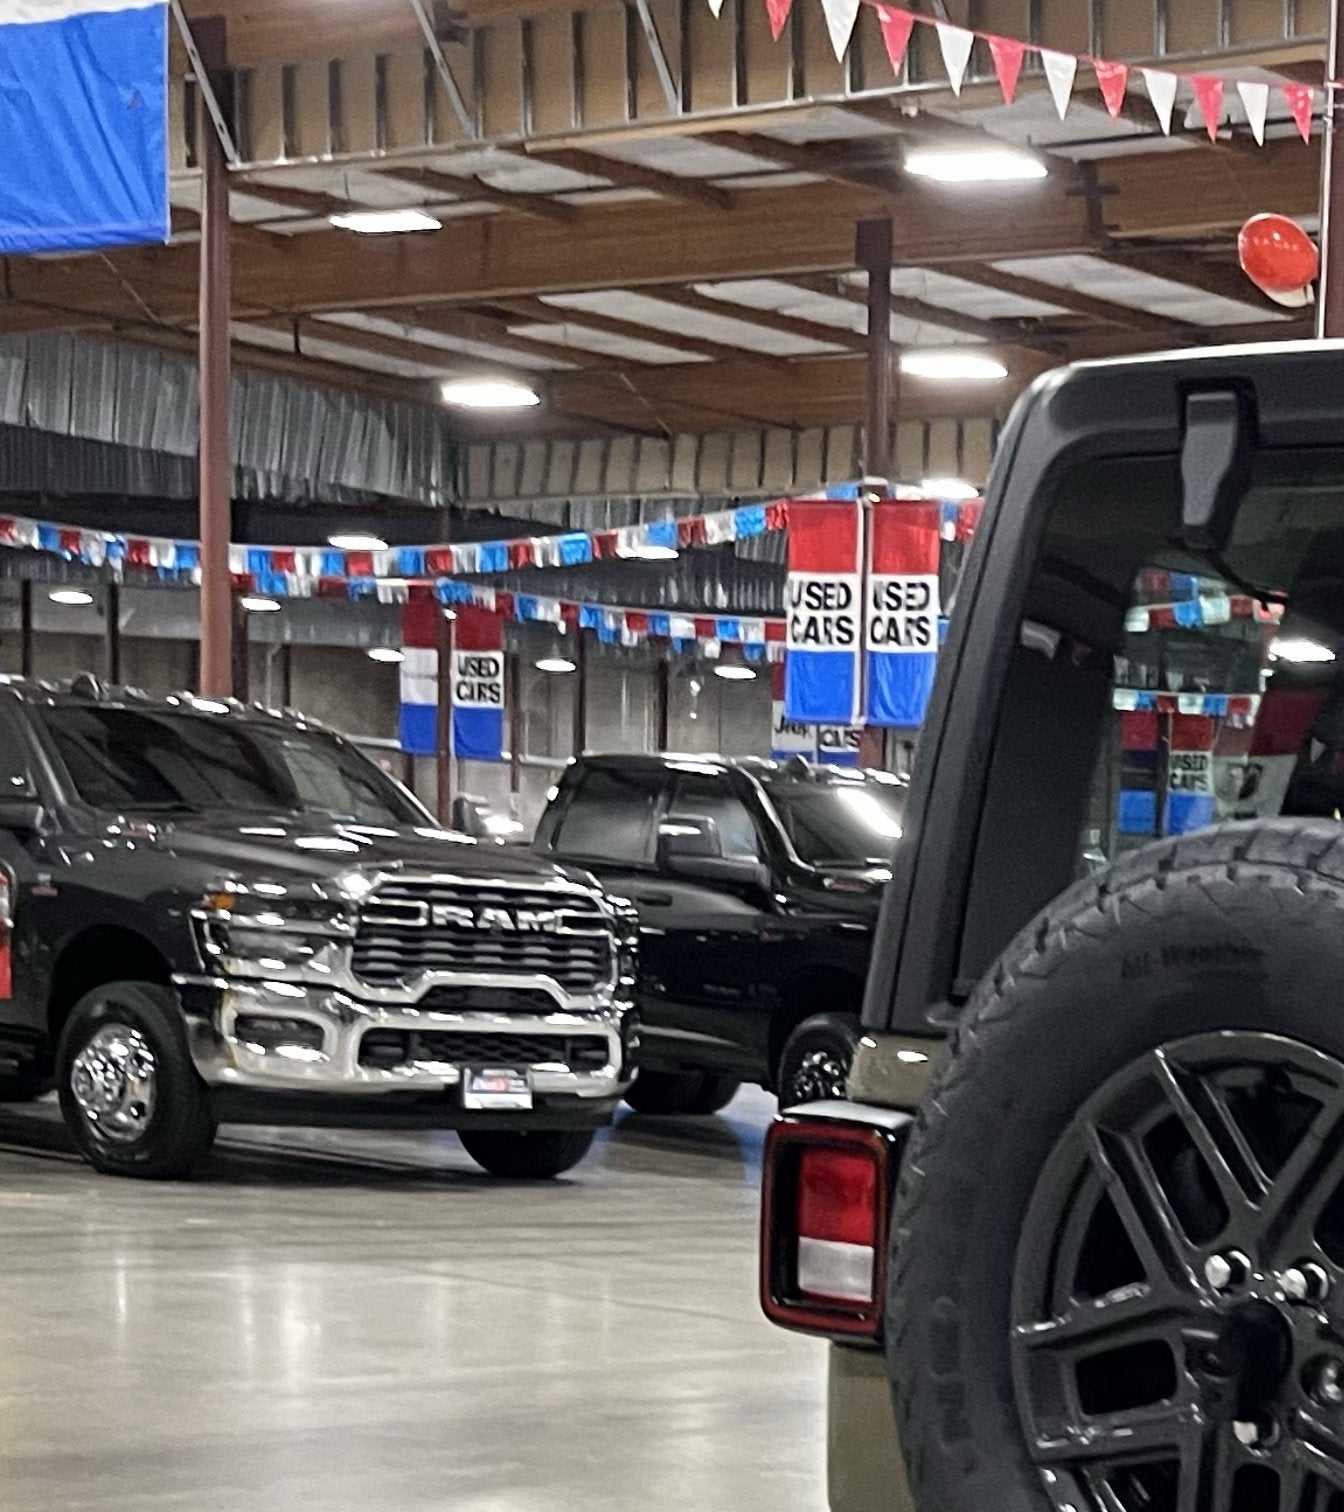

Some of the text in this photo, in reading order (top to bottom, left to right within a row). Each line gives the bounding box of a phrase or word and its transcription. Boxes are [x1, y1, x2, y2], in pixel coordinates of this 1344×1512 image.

[790, 580, 852, 611] USED
[873, 581, 931, 612] USED
[791, 615, 854, 645] CARS
[870, 615, 931, 646] CARS
[458, 655, 500, 679] USED
[432, 905, 558, 931] RAM
